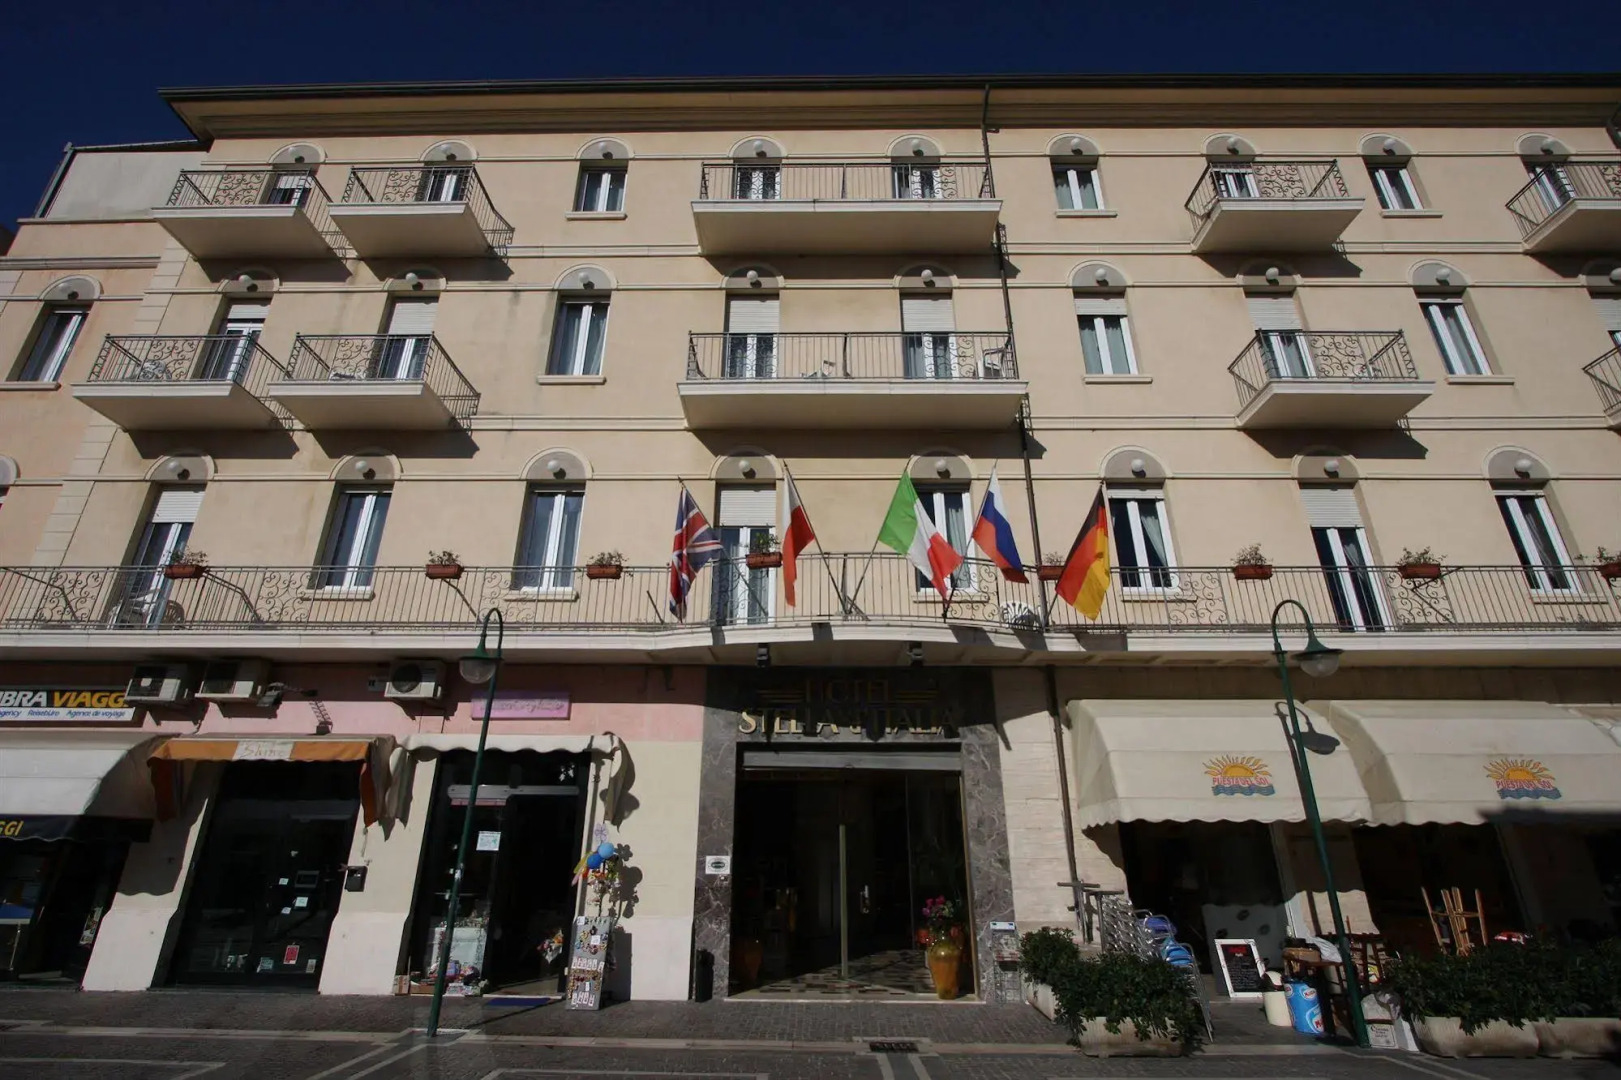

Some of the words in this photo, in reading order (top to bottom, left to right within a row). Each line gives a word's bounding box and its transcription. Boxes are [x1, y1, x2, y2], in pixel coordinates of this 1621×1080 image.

[53, 691, 129, 708] VIAGG
[66, 710, 91, 719] Agence
[101, 711, 126, 719] voyage
